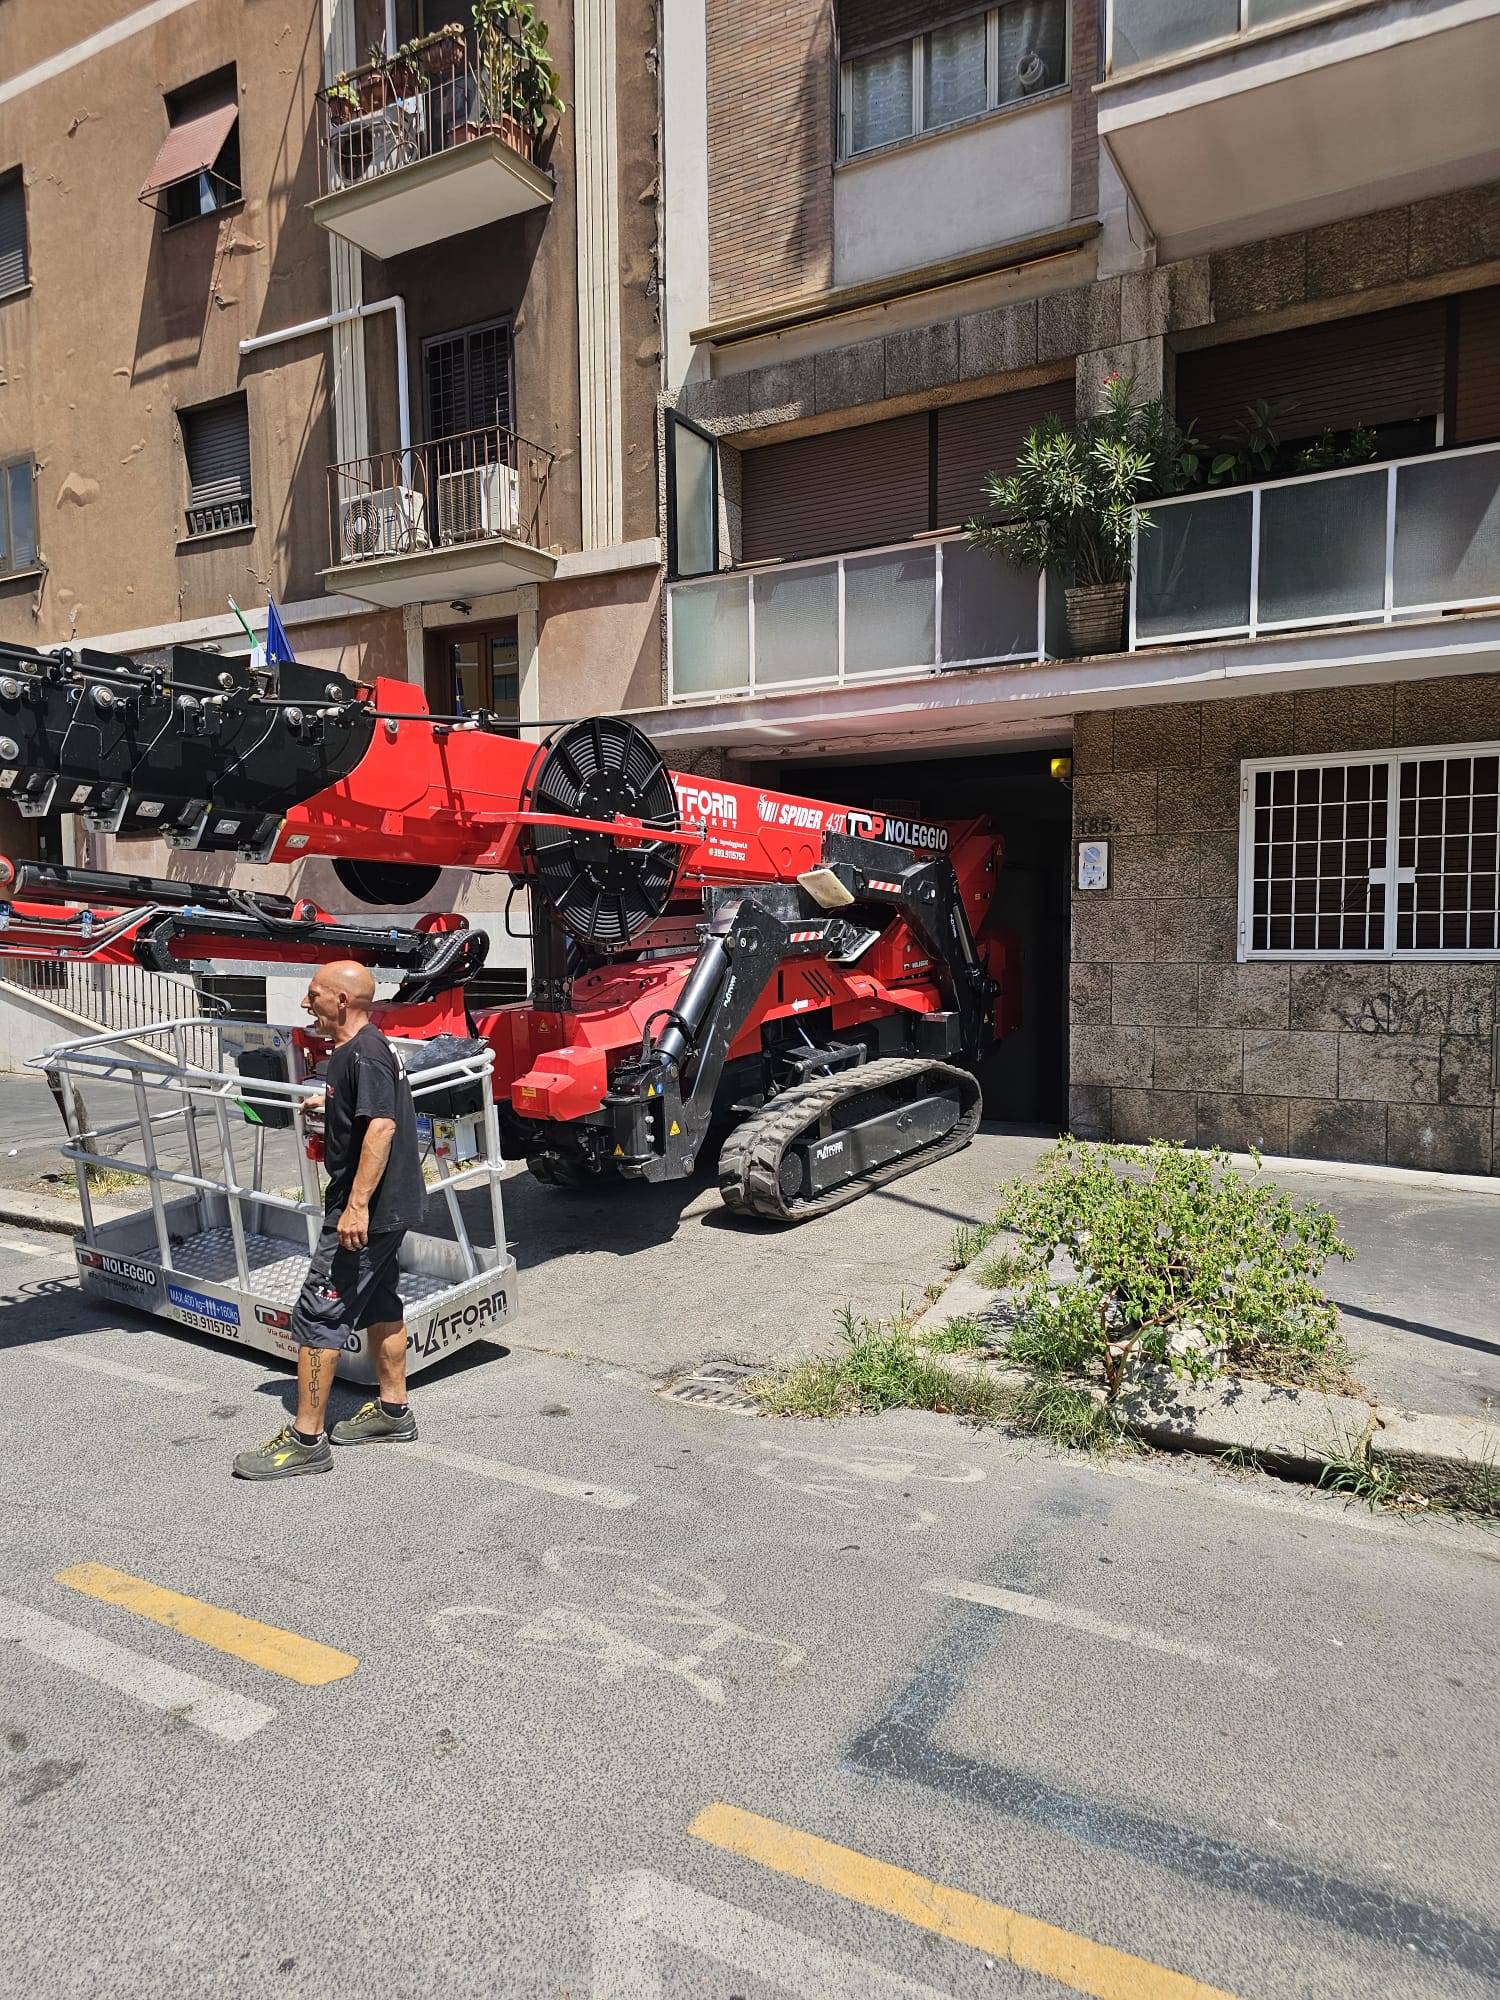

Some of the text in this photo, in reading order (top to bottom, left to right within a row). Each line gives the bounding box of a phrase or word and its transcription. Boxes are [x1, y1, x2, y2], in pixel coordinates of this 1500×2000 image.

[672, 774, 737, 820] TFORM
[779, 805, 823, 830] SPIDER
[847, 812, 948, 851] TOP NOLEGGIO
[76, 1248, 156, 1286] TOP NOLEGGIO
[181, 1310, 239, 1338] 393.9115792
[255, 1305, 290, 1328] TOP
[267, 1327, 278, 1337] Via
[444, 1309, 508, 1347] BASKET
